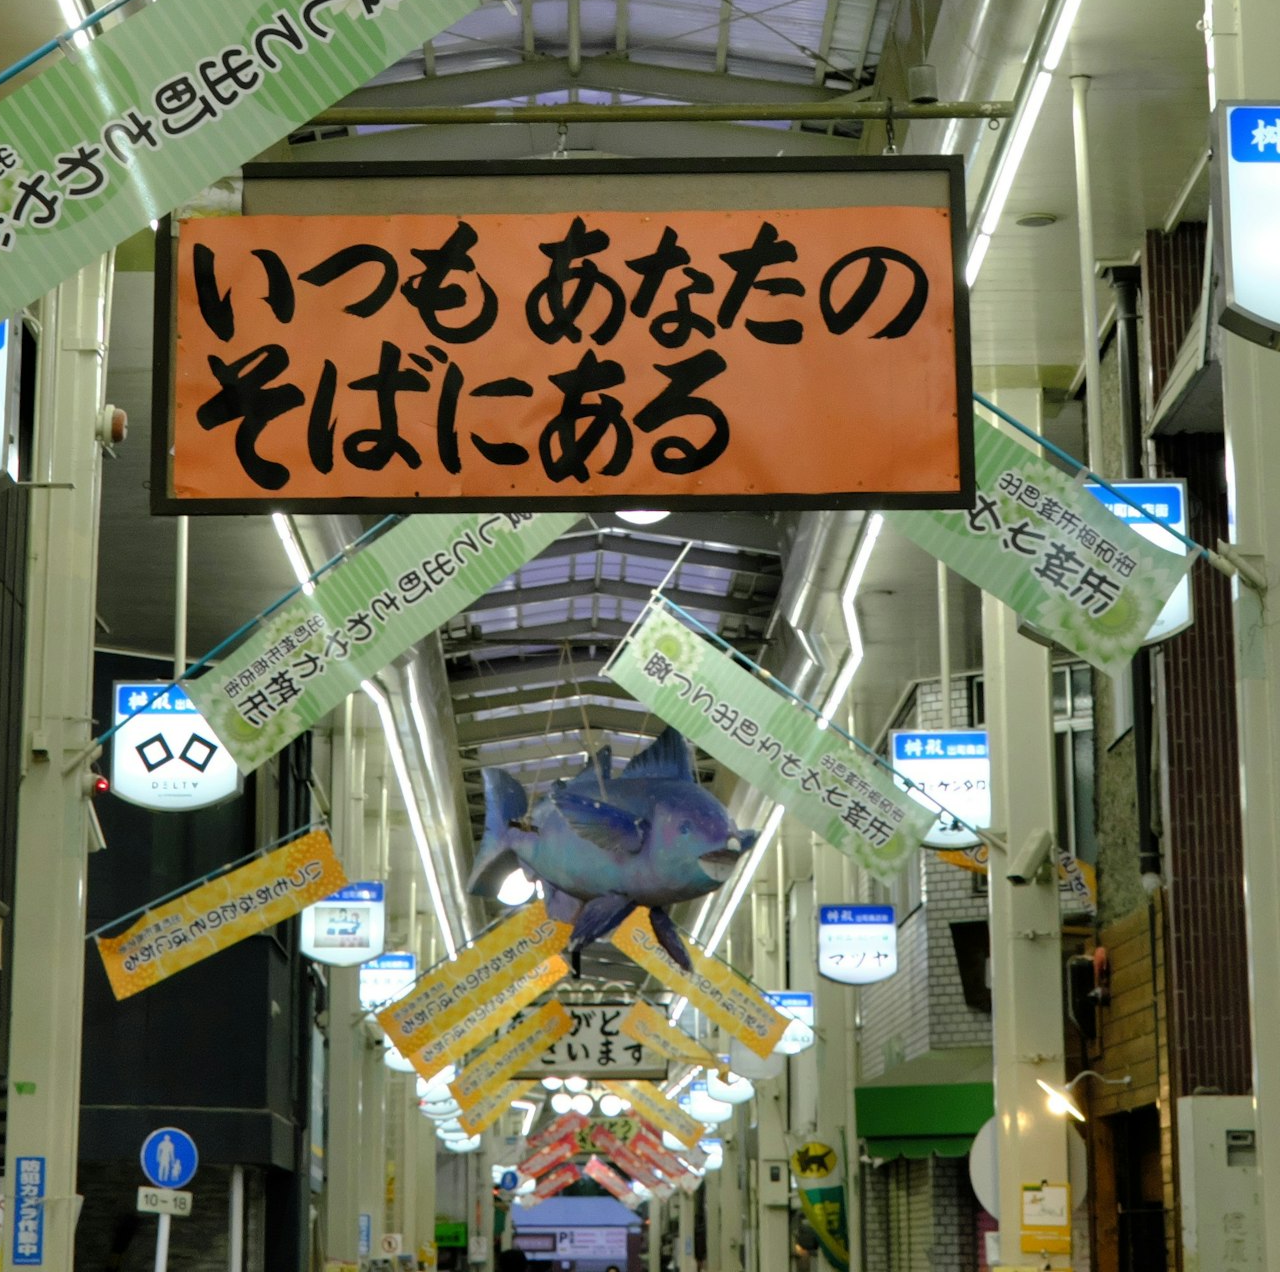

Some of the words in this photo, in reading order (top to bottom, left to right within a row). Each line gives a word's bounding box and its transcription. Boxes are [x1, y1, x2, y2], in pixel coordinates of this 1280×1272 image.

[197, 341, 731, 491] そばにある
